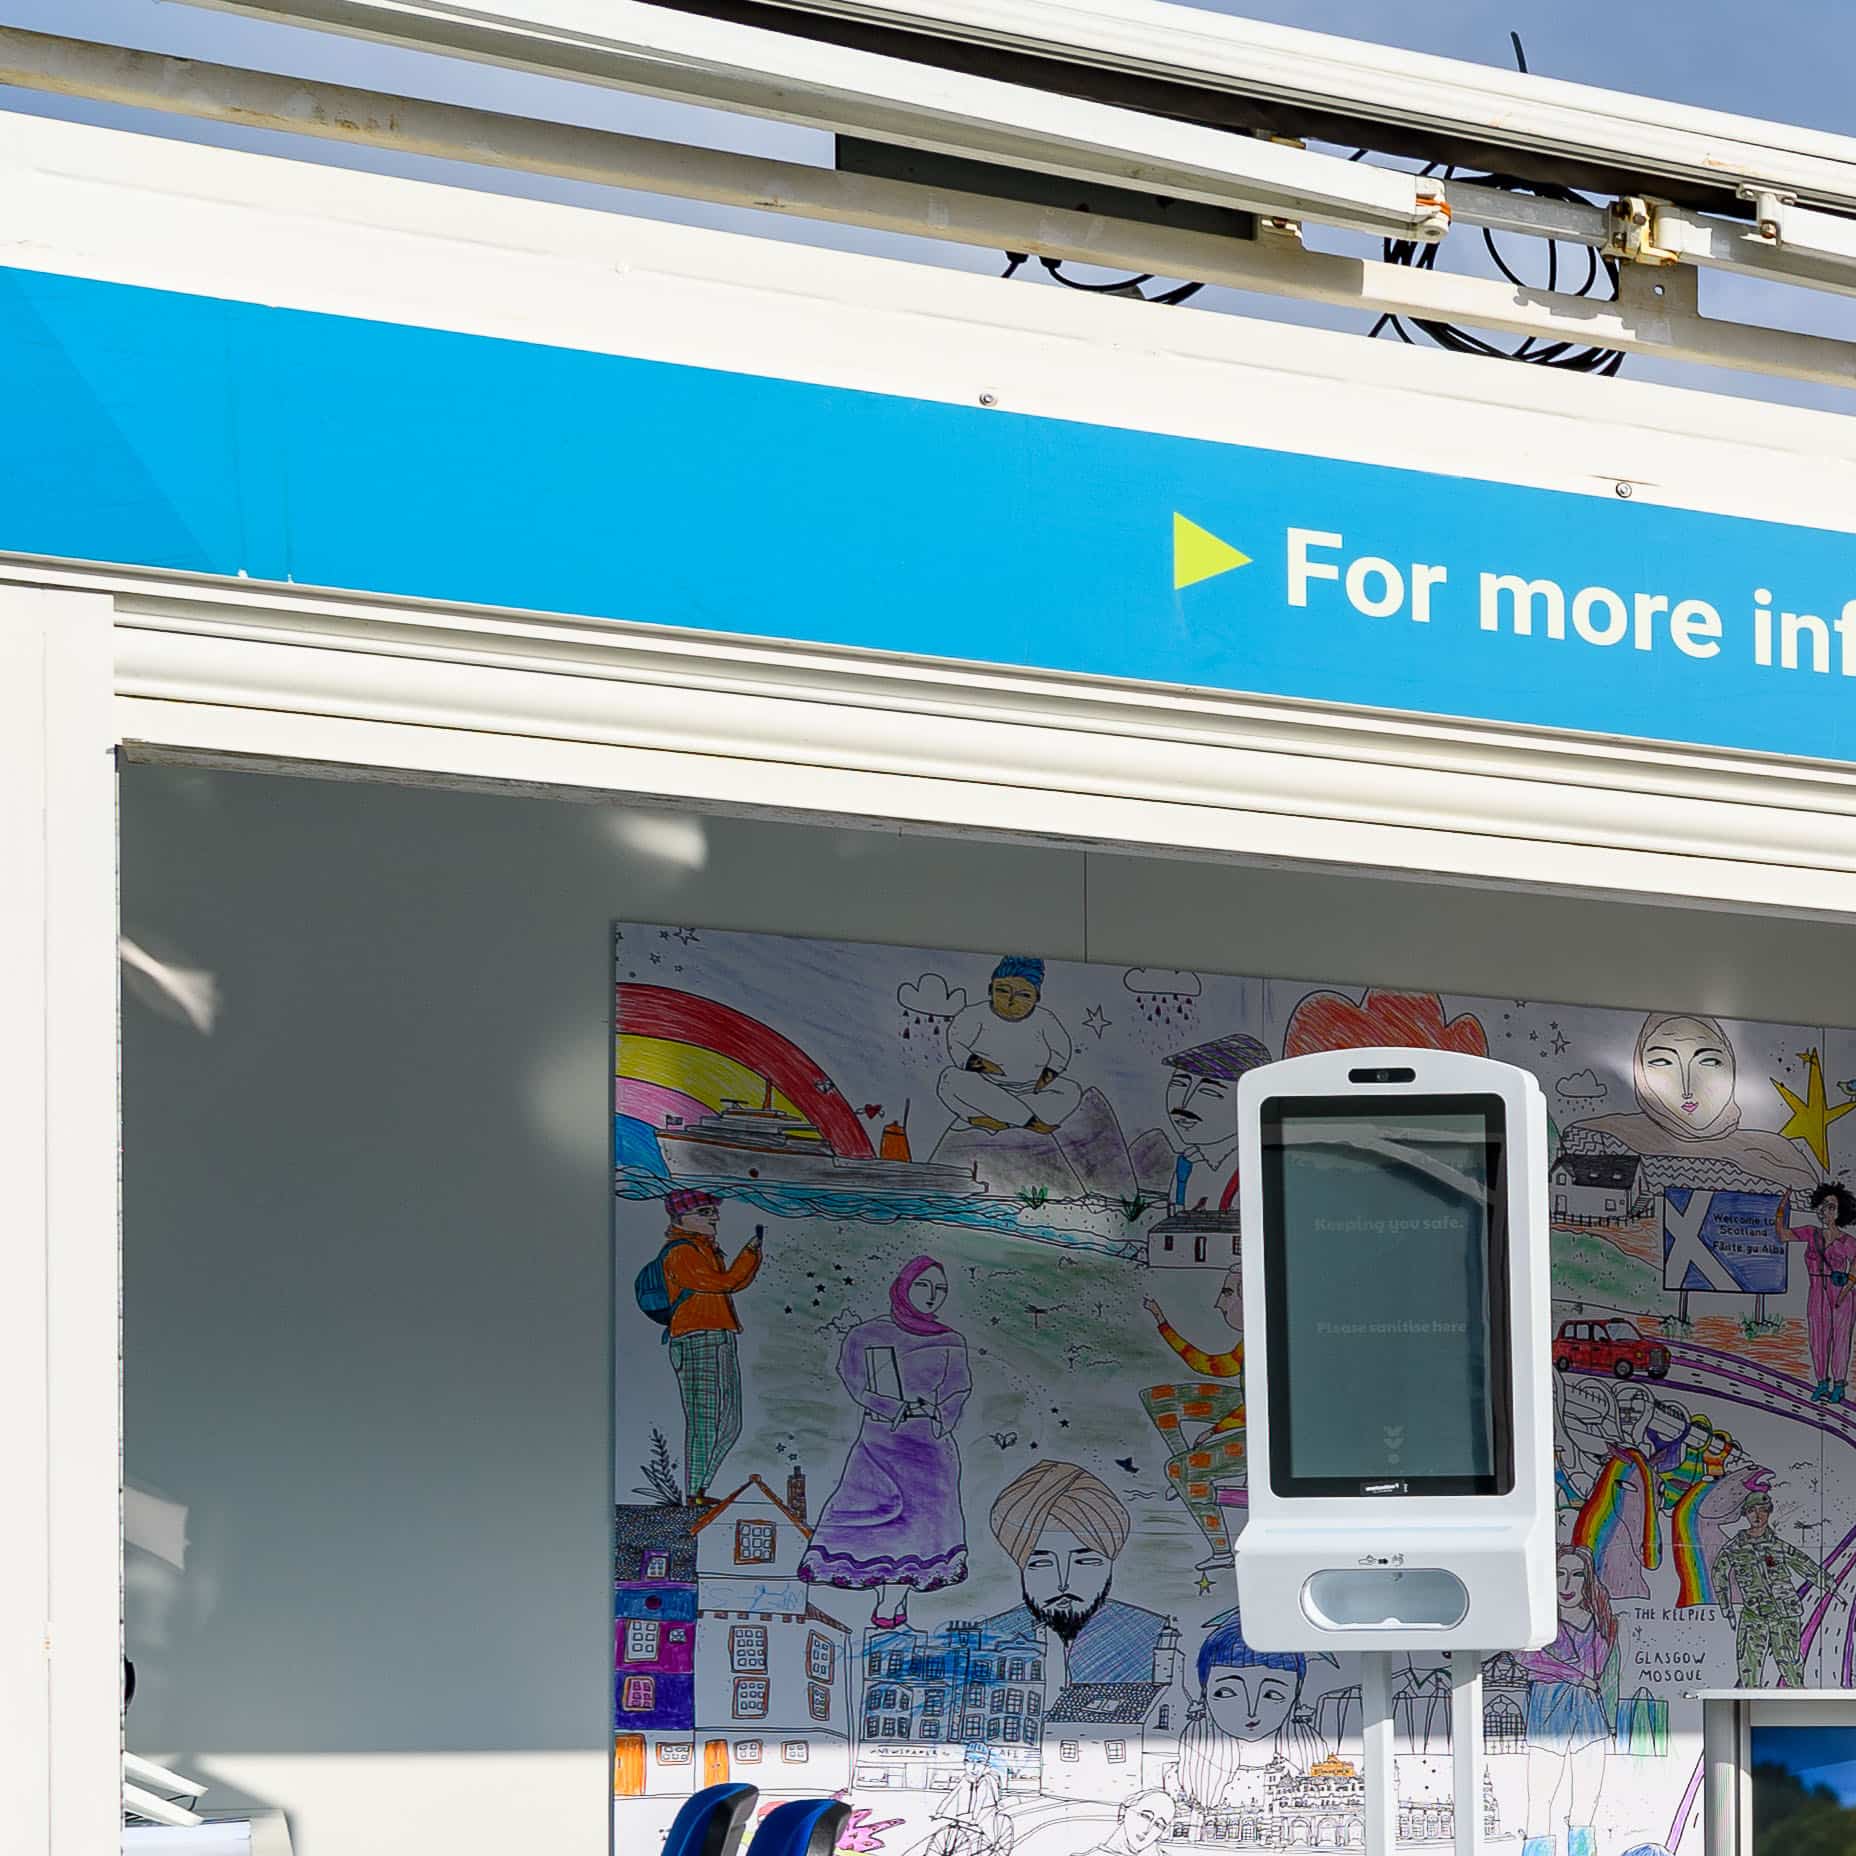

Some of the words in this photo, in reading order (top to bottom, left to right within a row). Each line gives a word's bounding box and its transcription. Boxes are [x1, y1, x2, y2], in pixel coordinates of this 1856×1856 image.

[1286, 527, 1447, 622] For
[1479, 571, 1723, 659] more
[1634, 1607, 1656, 1620] THE
[1662, 1608, 1716, 1621] KELPIES
[1635, 1651, 1706, 1665] GLASGOW
[1638, 1669, 1702, 1682] MOSQUE
